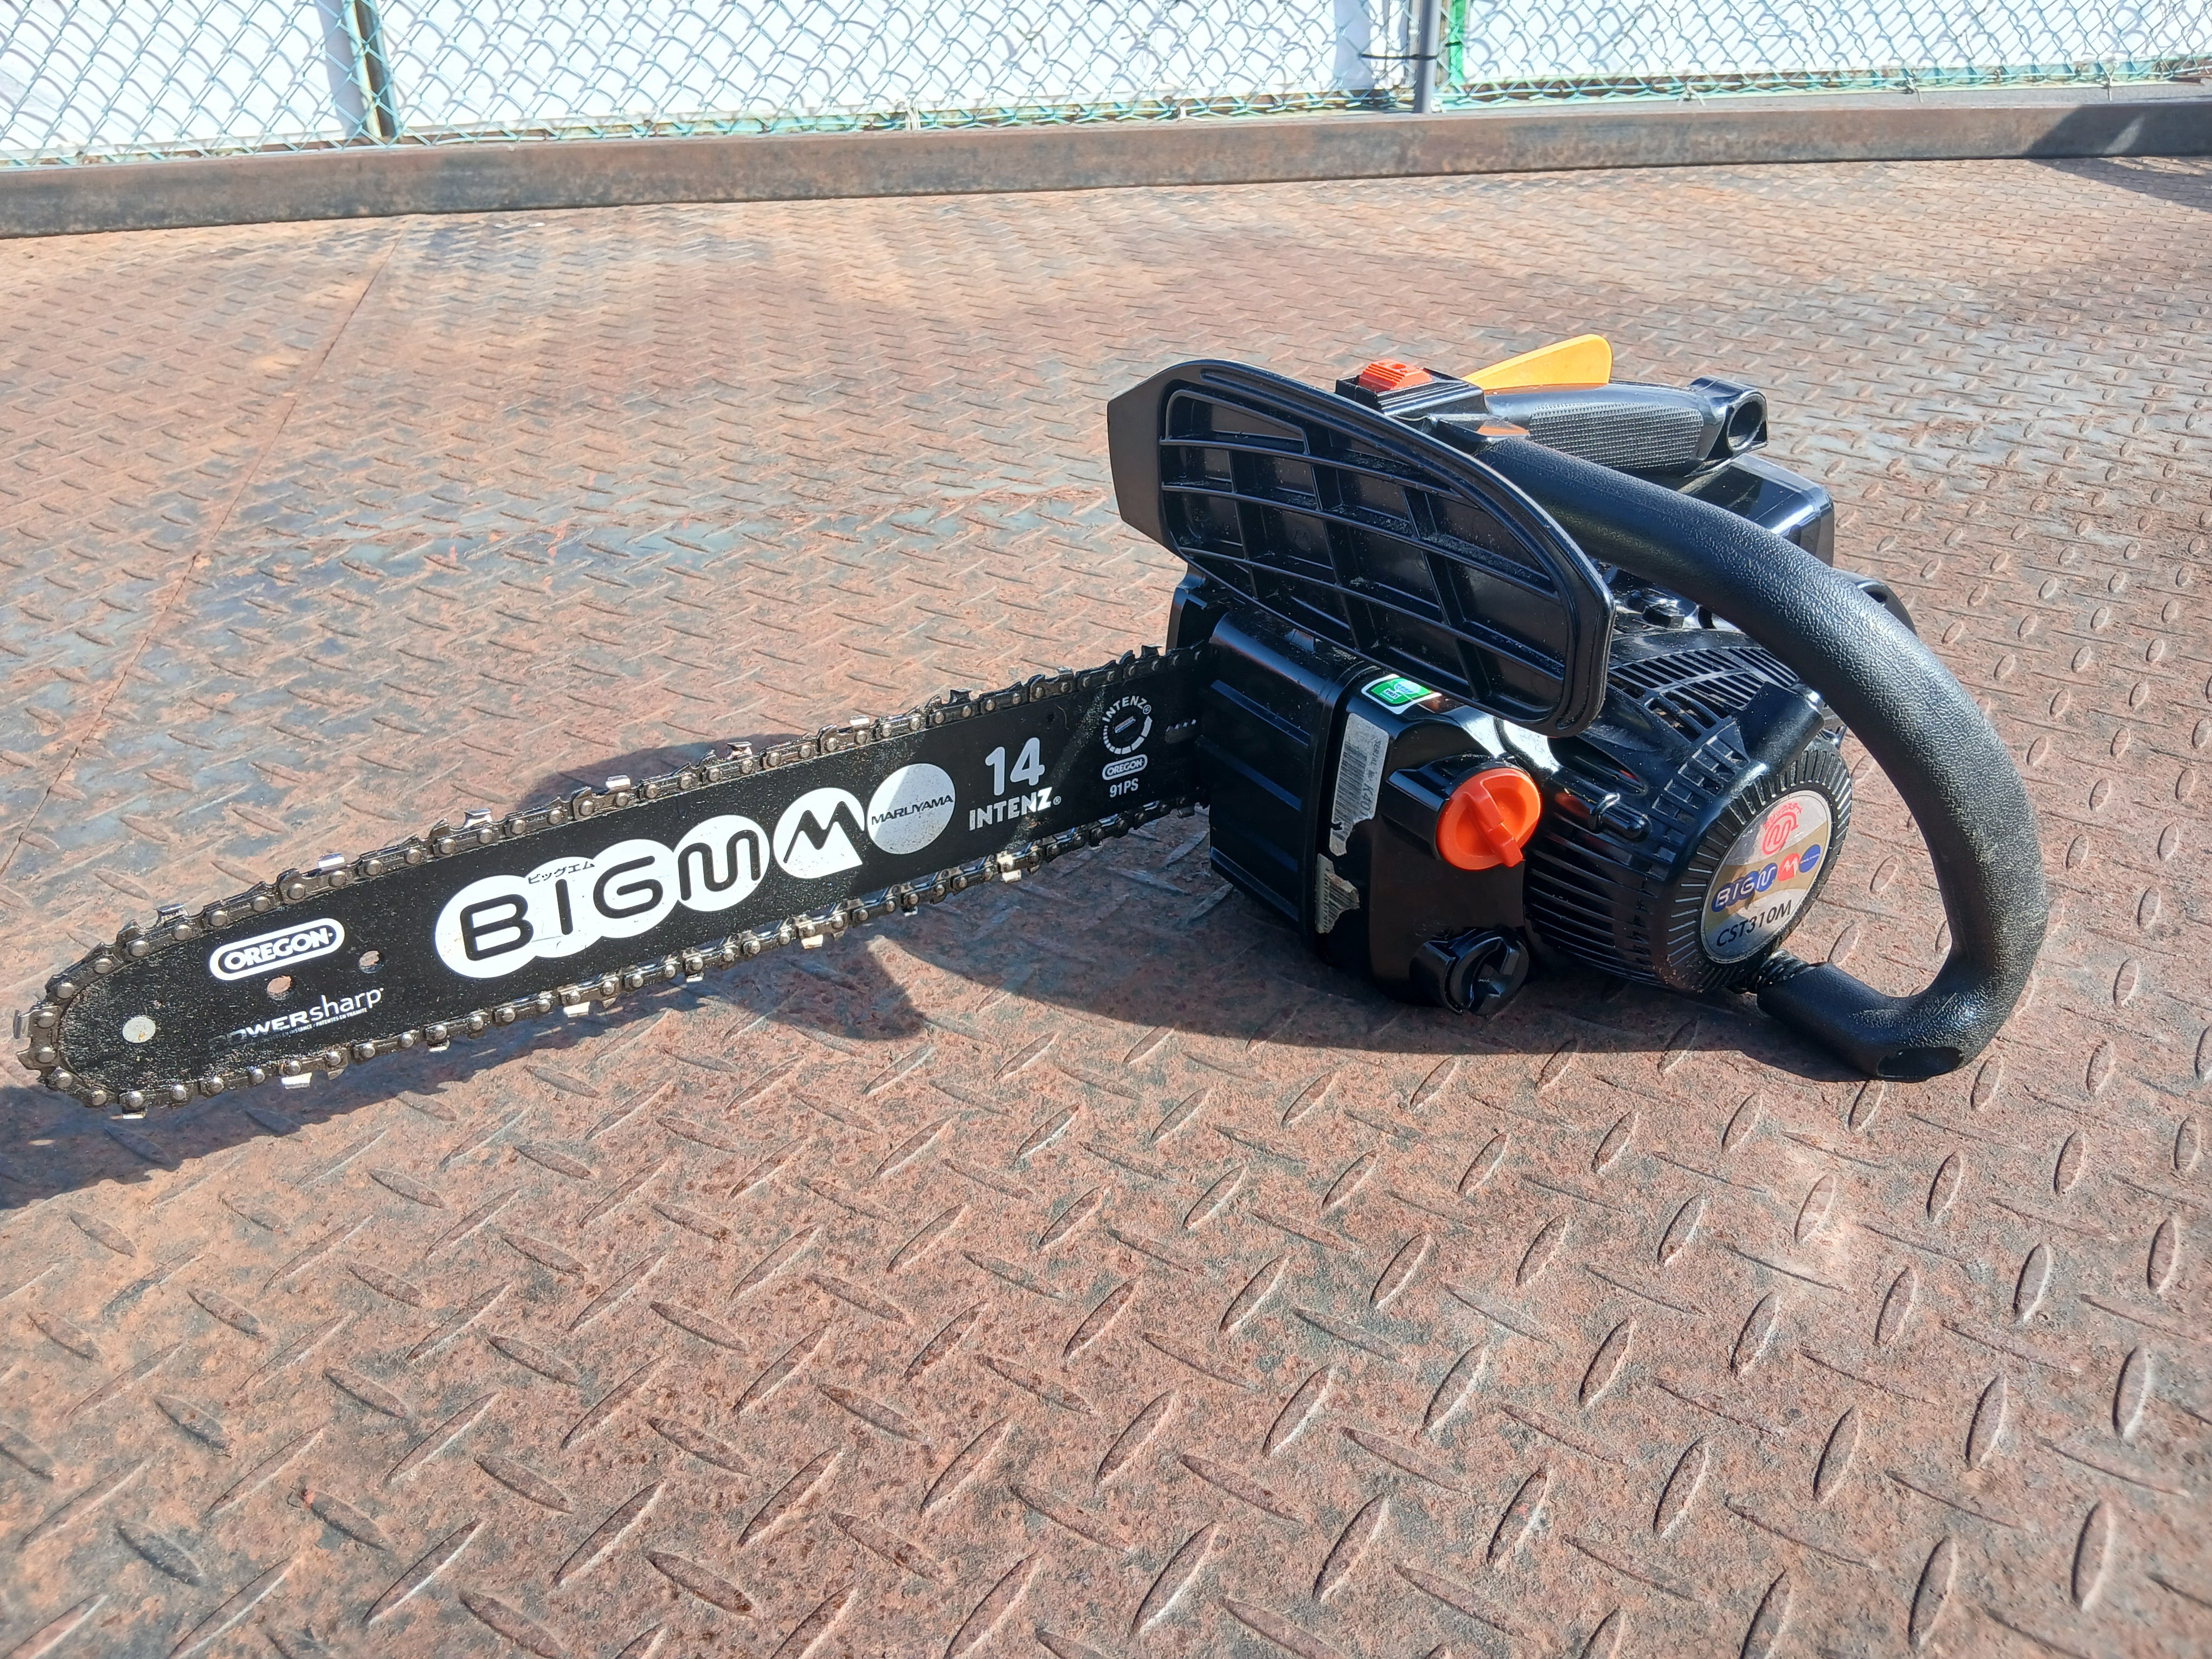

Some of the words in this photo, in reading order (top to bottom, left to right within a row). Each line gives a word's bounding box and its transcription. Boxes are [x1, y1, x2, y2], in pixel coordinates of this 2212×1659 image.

[985, 737, 1045, 796] 14
[1107, 758, 1144, 776] OREGON
[1109, 778, 1139, 798] 91PS
[871, 795, 954, 825] MARUYAMA
[528, 861, 595, 884] ビッグエム
[1716, 900, 1792, 947] CST310M
[224, 928, 332, 970] OREGON
